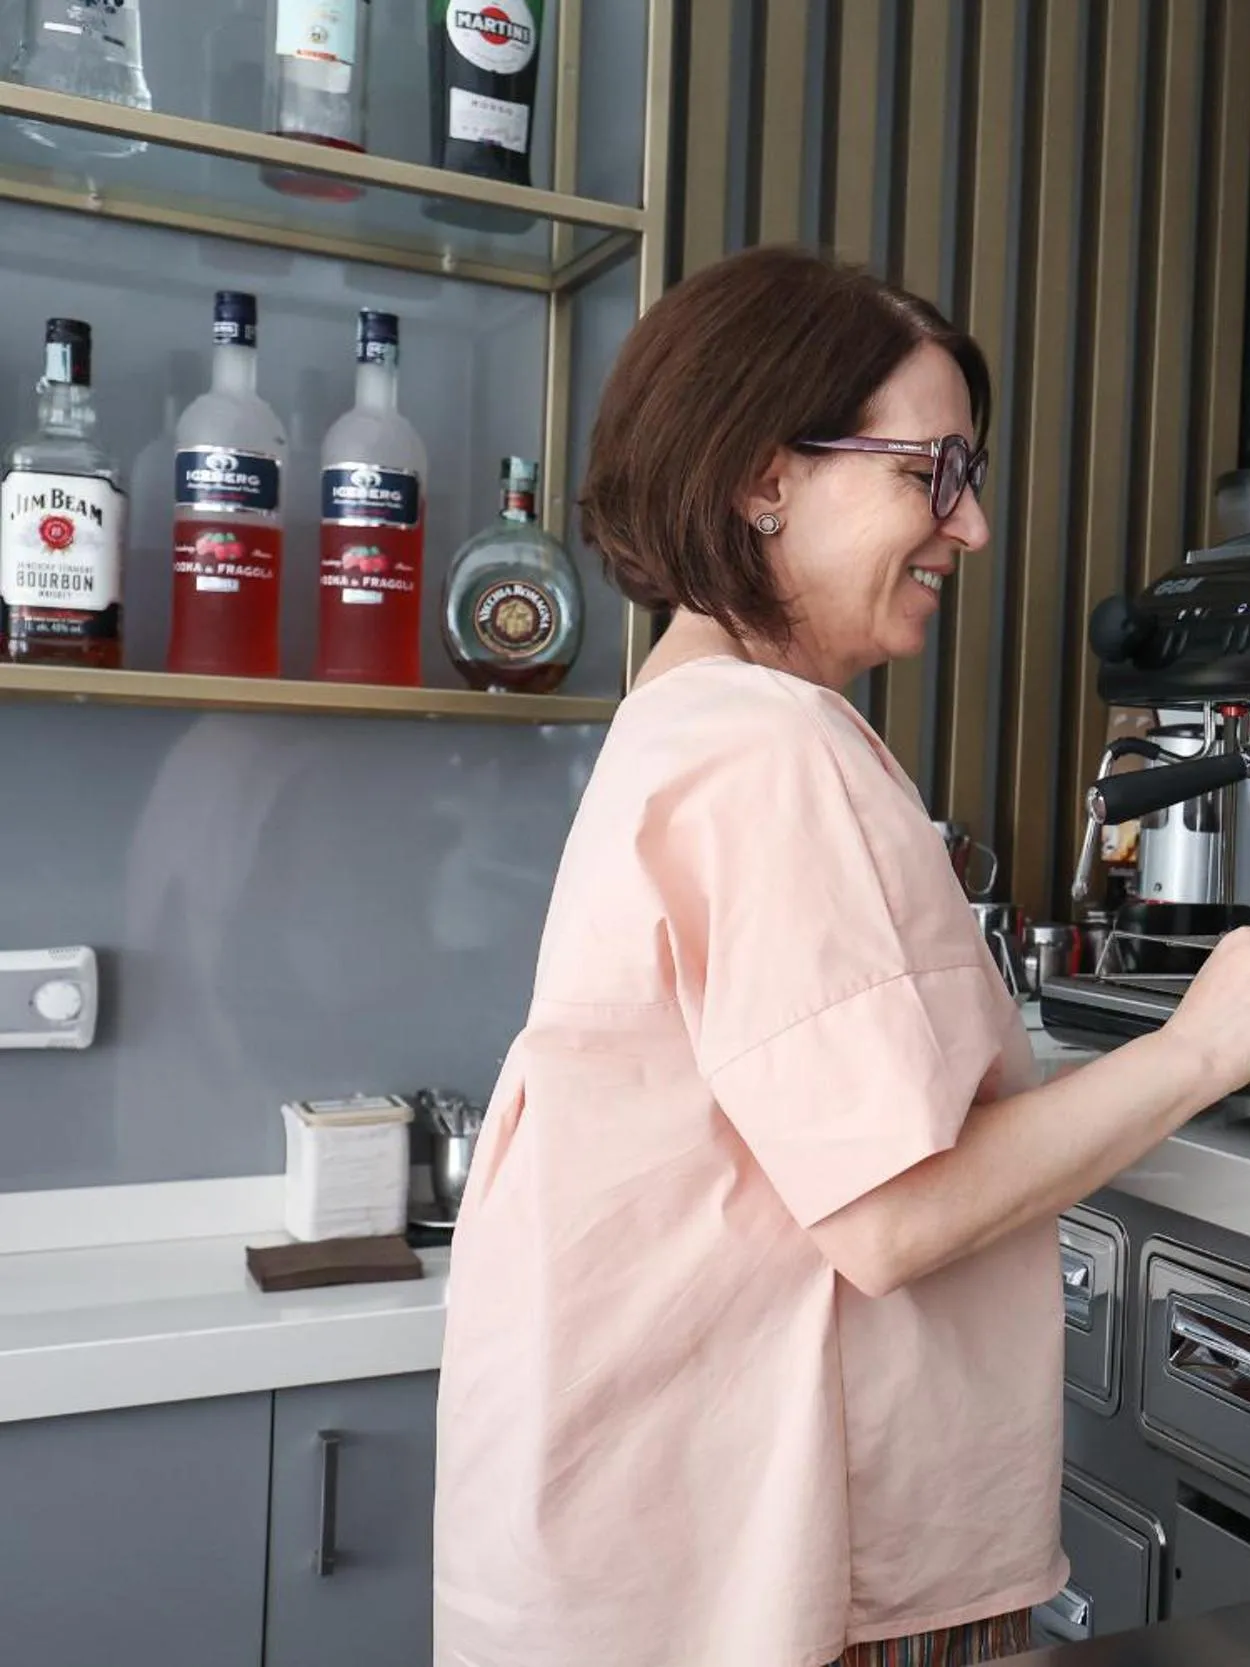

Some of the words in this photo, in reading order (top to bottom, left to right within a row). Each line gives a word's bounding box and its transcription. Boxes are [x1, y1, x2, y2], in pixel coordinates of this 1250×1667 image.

[456, 10, 530, 45] MARTINI
[11, 493, 46, 520] JIM
[51, 487, 103, 527] BEAM
[17, 570, 94, 592] BOURBON
